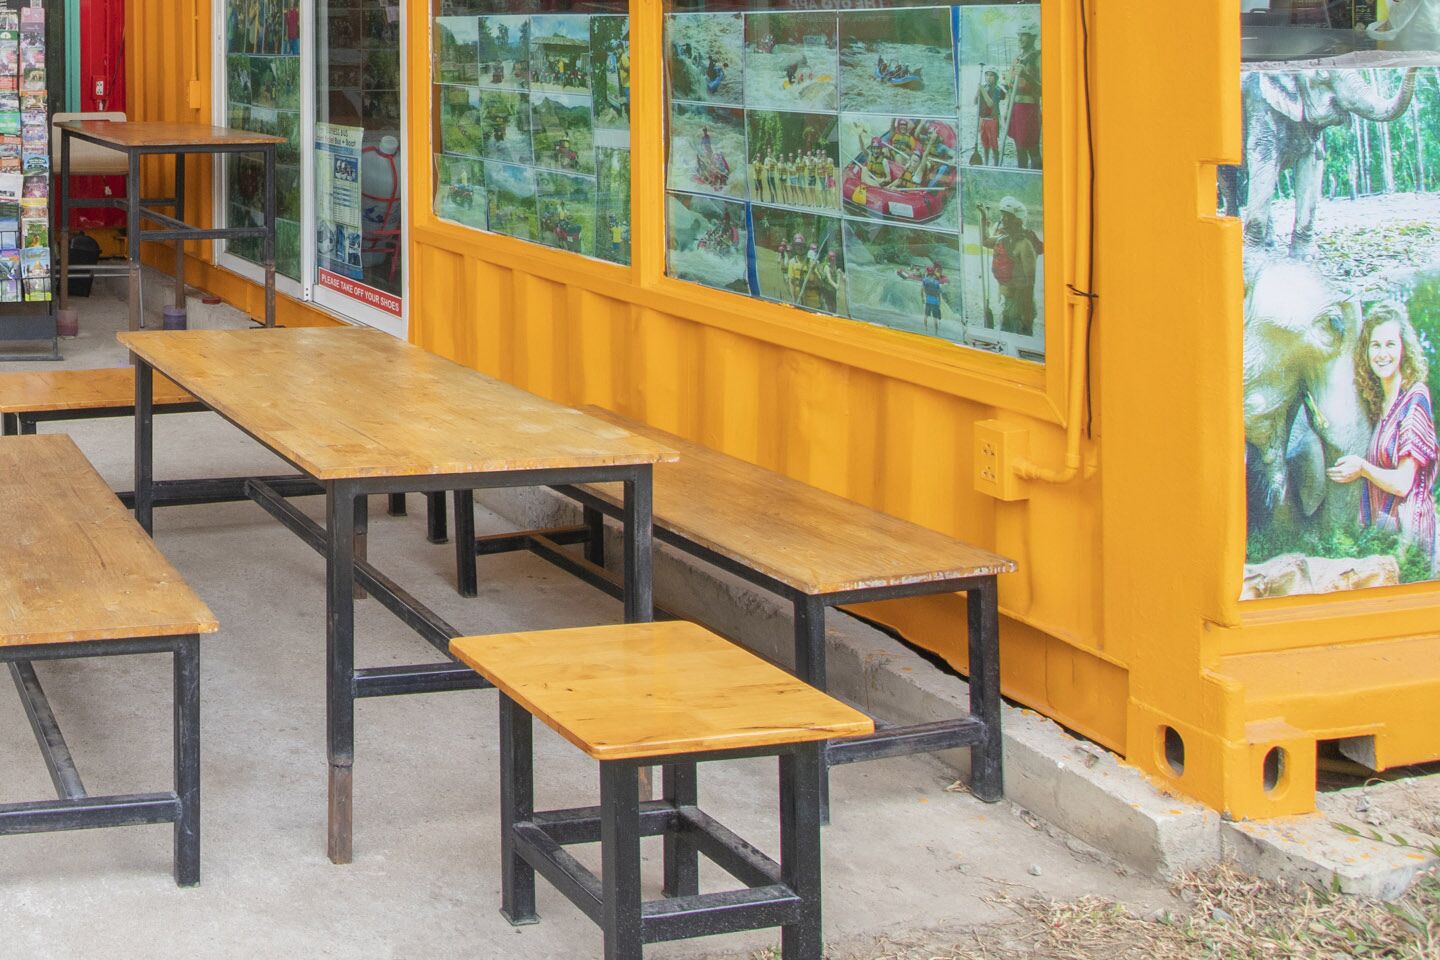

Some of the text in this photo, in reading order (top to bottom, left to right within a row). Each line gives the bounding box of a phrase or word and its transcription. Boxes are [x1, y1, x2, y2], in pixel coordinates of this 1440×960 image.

[321, 275, 400, 312] PLEASE TAKE OFF YOUR SHOES
